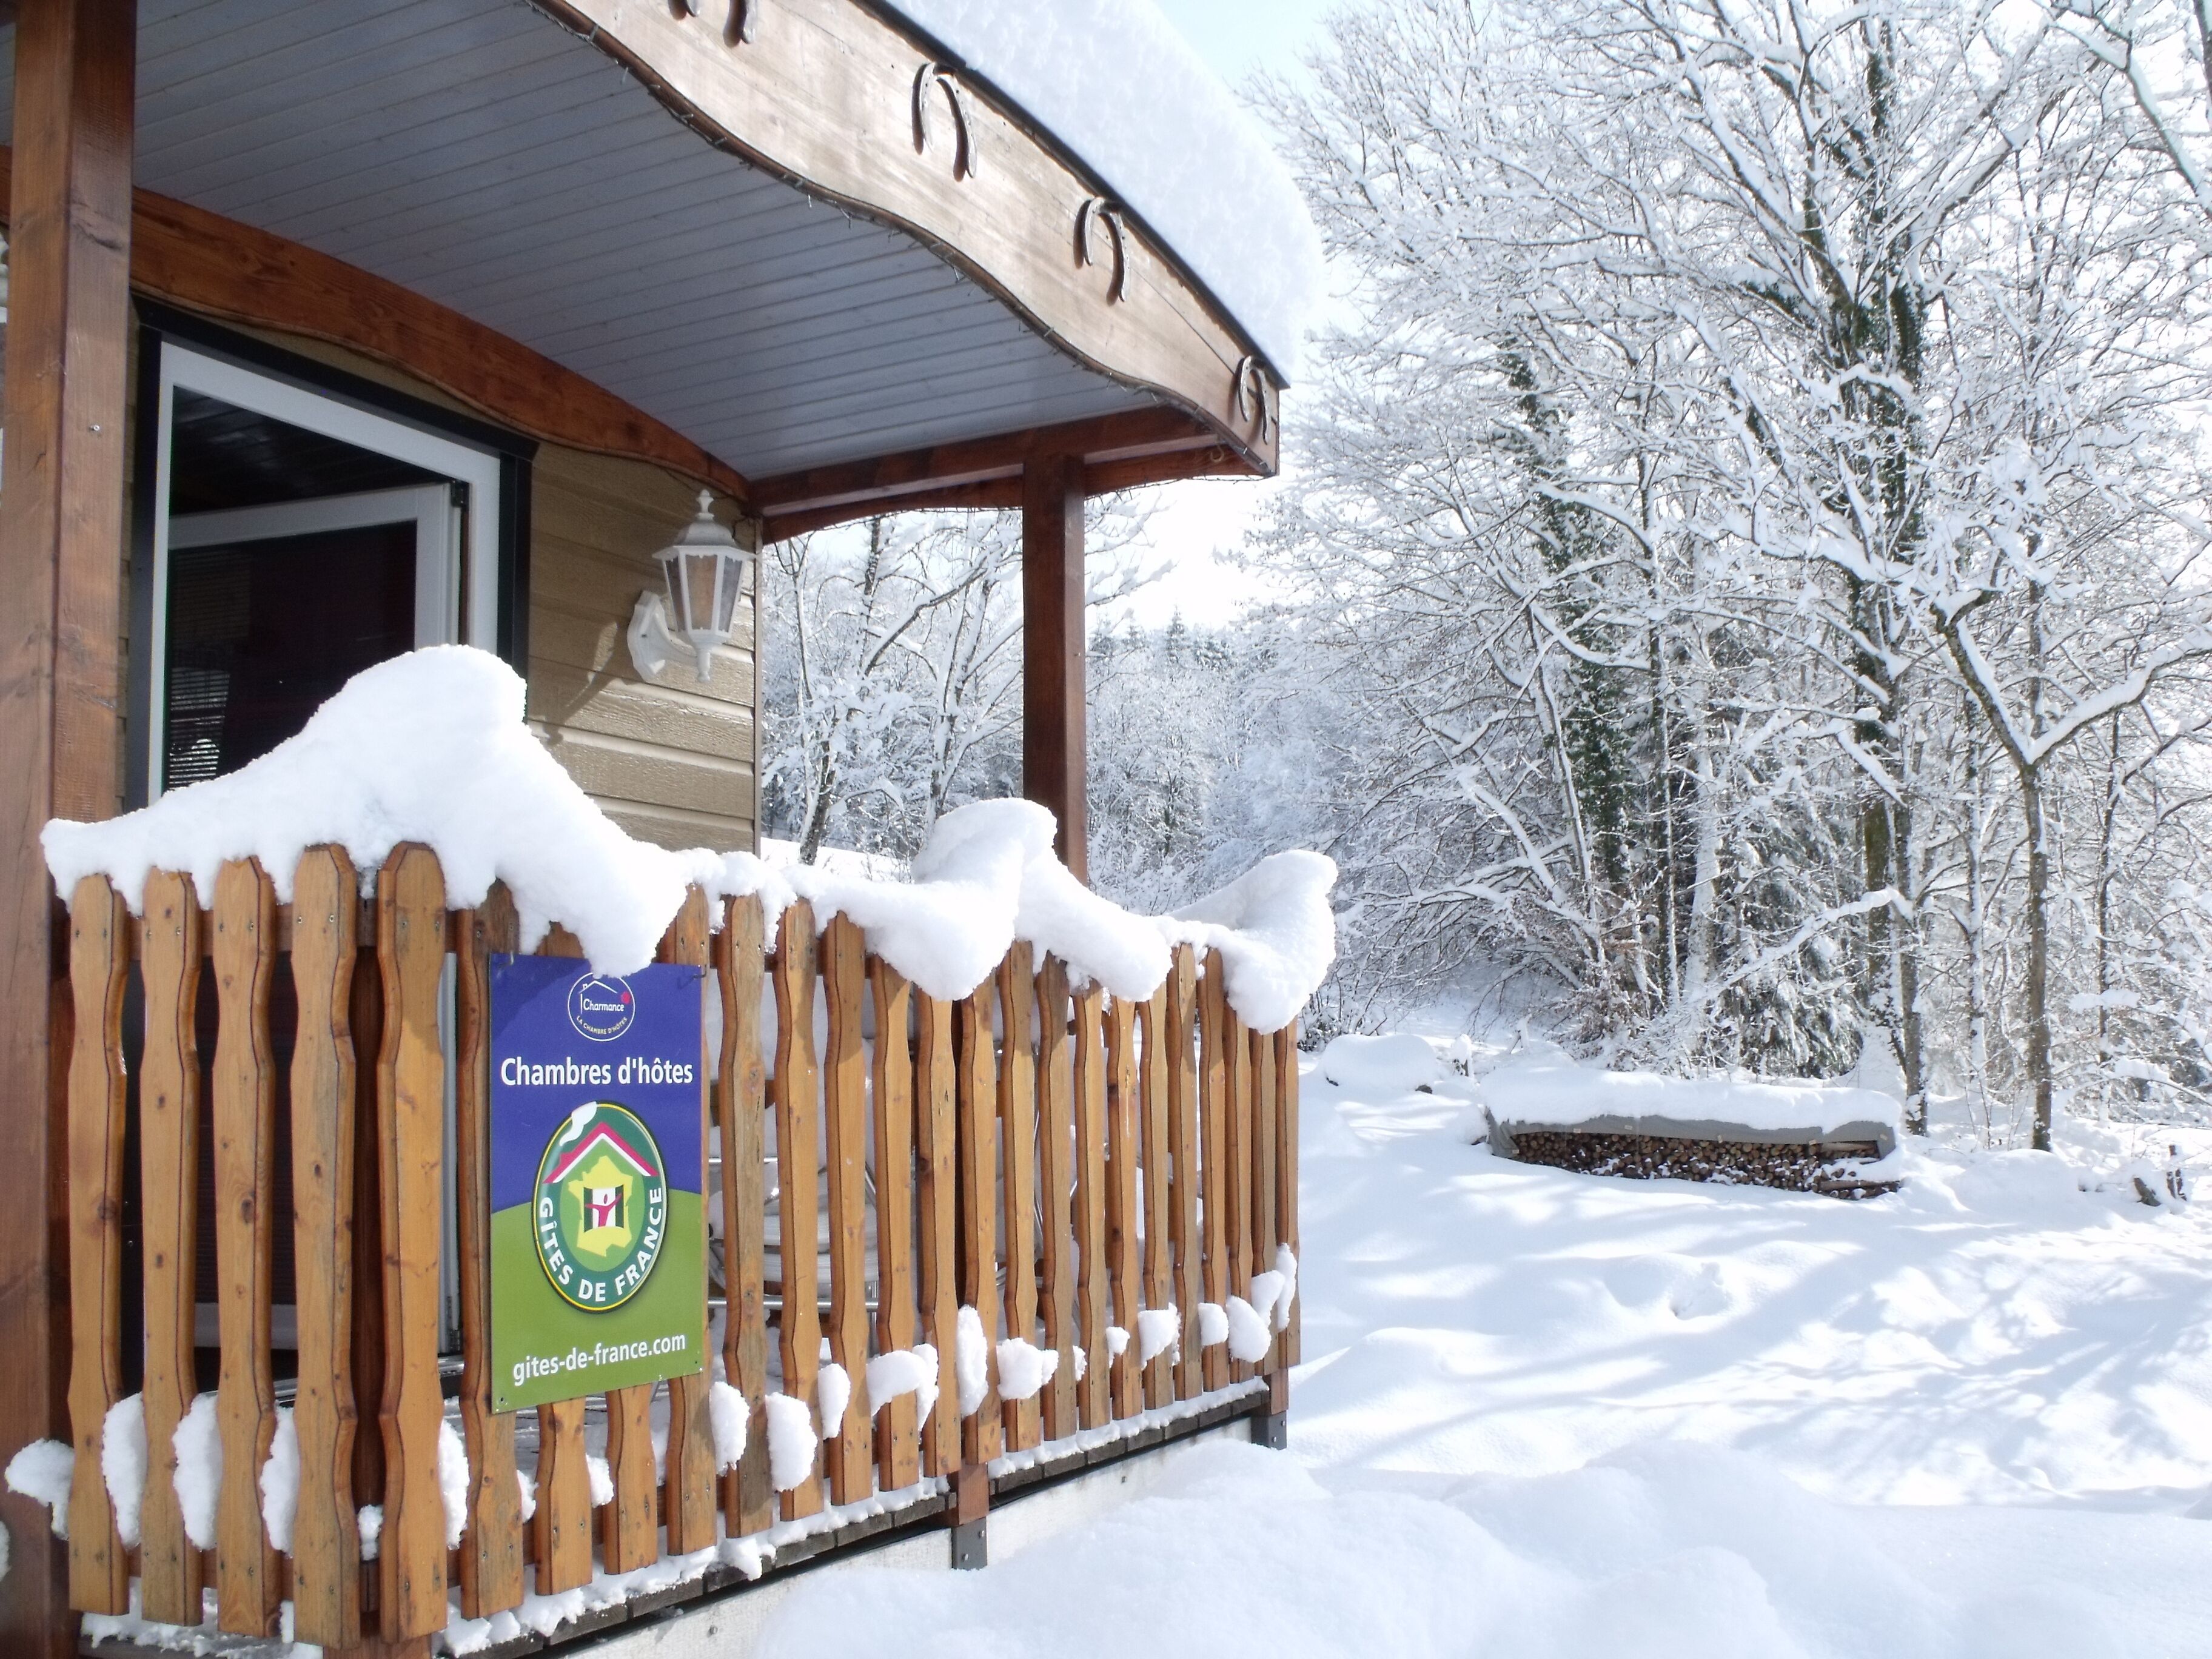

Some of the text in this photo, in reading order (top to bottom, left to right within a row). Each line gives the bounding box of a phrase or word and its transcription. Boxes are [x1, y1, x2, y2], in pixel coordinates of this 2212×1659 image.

[583, 999, 625, 1011] Charmance
[501, 1056, 693, 1085] Chambres d'hôtes
[538, 1187, 662, 1302] GÎTES DE FRANCE
[513, 1334, 686, 1386] gites-de-france.com
